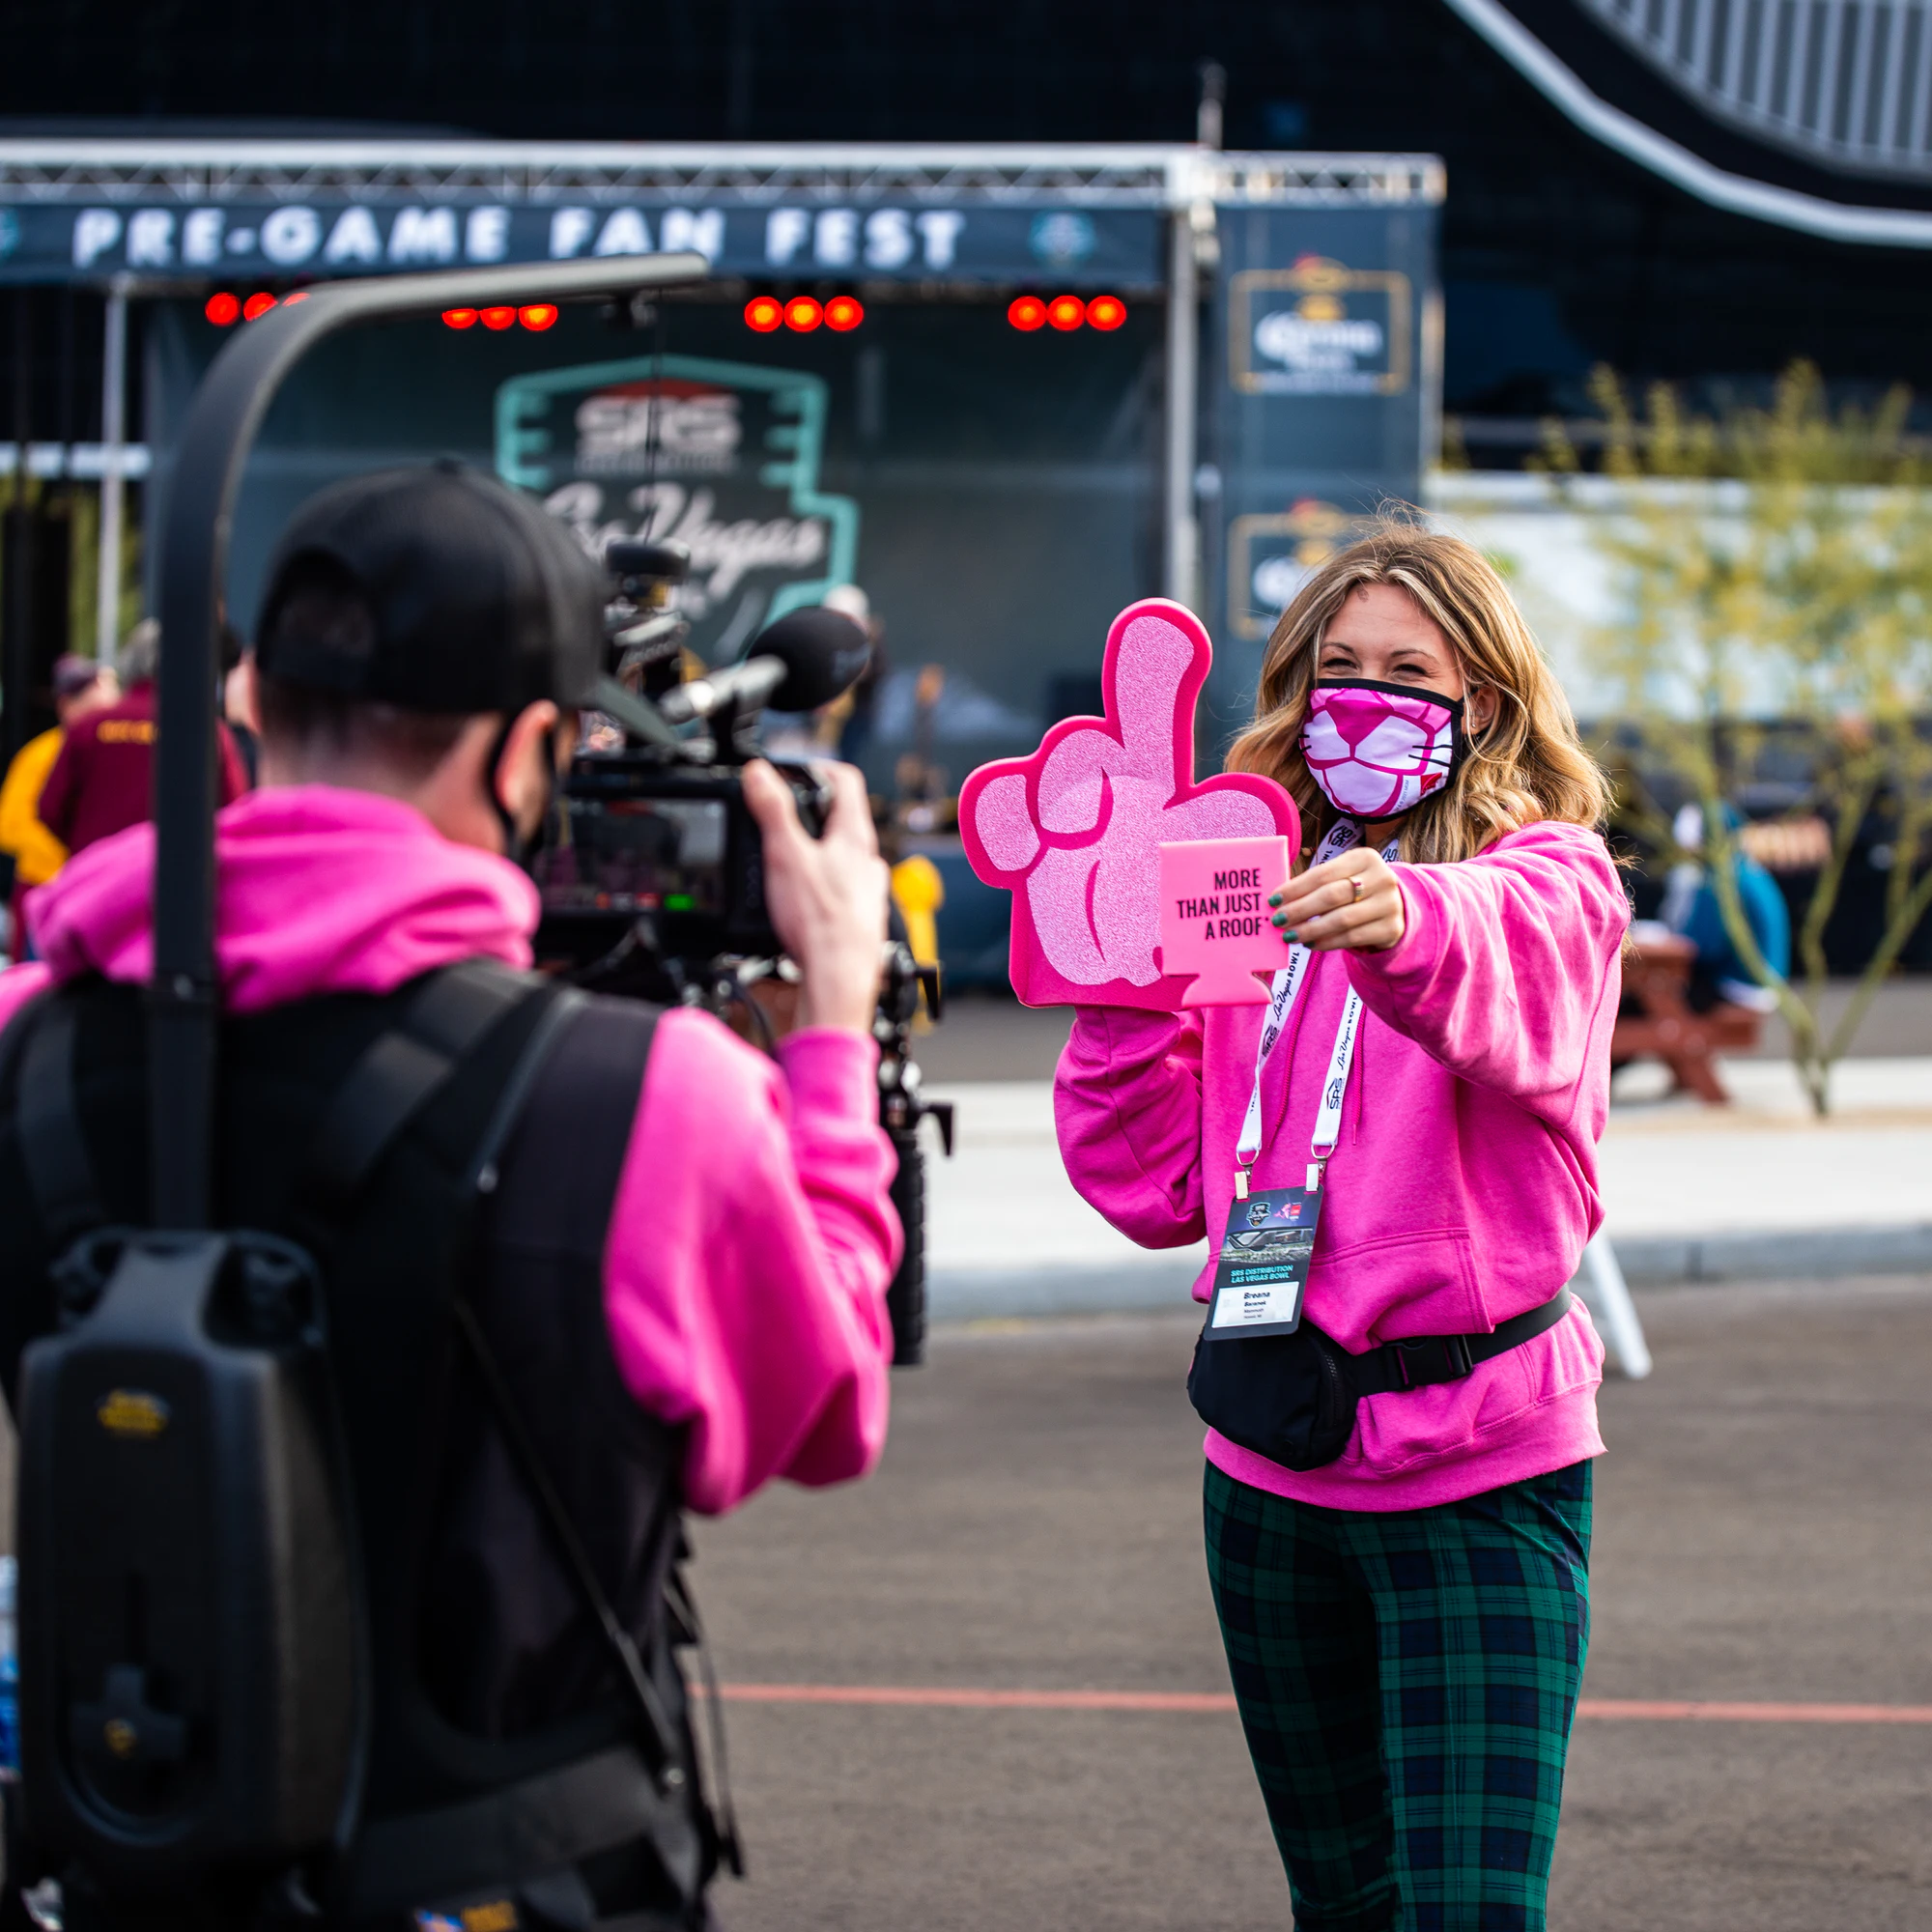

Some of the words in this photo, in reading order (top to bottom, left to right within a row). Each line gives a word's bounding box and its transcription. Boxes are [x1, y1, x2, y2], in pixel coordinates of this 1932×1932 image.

[72, 206, 510, 269] PRE-GAME
[550, 206, 725, 266] FAN
[765, 207, 964, 270] FEST
[1331, 825, 1353, 847] SRS
[1214, 868, 1261, 890] MORE
[1177, 897, 1219, 919] THAN
[1225, 893, 1261, 914] JUST
[1206, 921, 1215, 940] A
[1277, 980, 1292, 1004] Vegas
[1287, 952, 1300, 978] BOWL
[1339, 1027, 1351, 1052] Vegas
[1348, 996, 1358, 1024] BOWL
[1329, 1077, 1343, 1109] SRS
[1244, 1264, 1293, 1275] DISTRIBUTION
